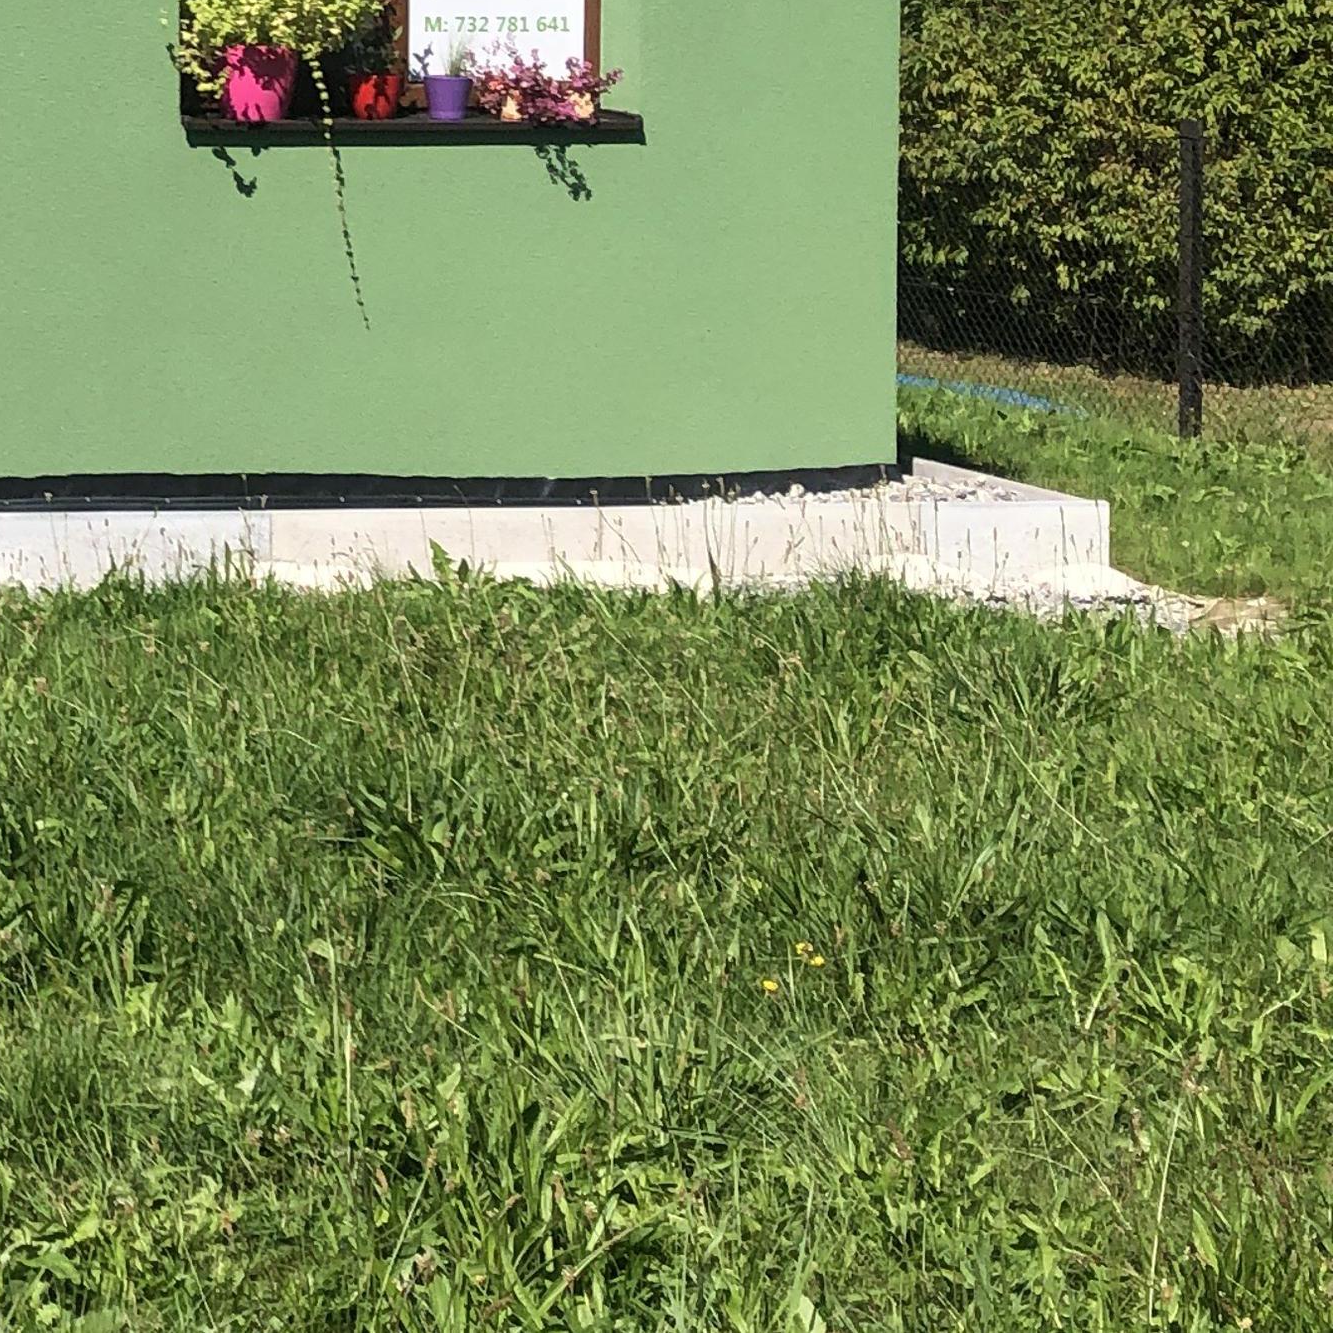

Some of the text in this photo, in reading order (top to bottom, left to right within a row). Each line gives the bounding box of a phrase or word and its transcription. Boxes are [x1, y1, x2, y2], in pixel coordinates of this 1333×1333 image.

[424, 16, 571, 32] M: 732 781 641
